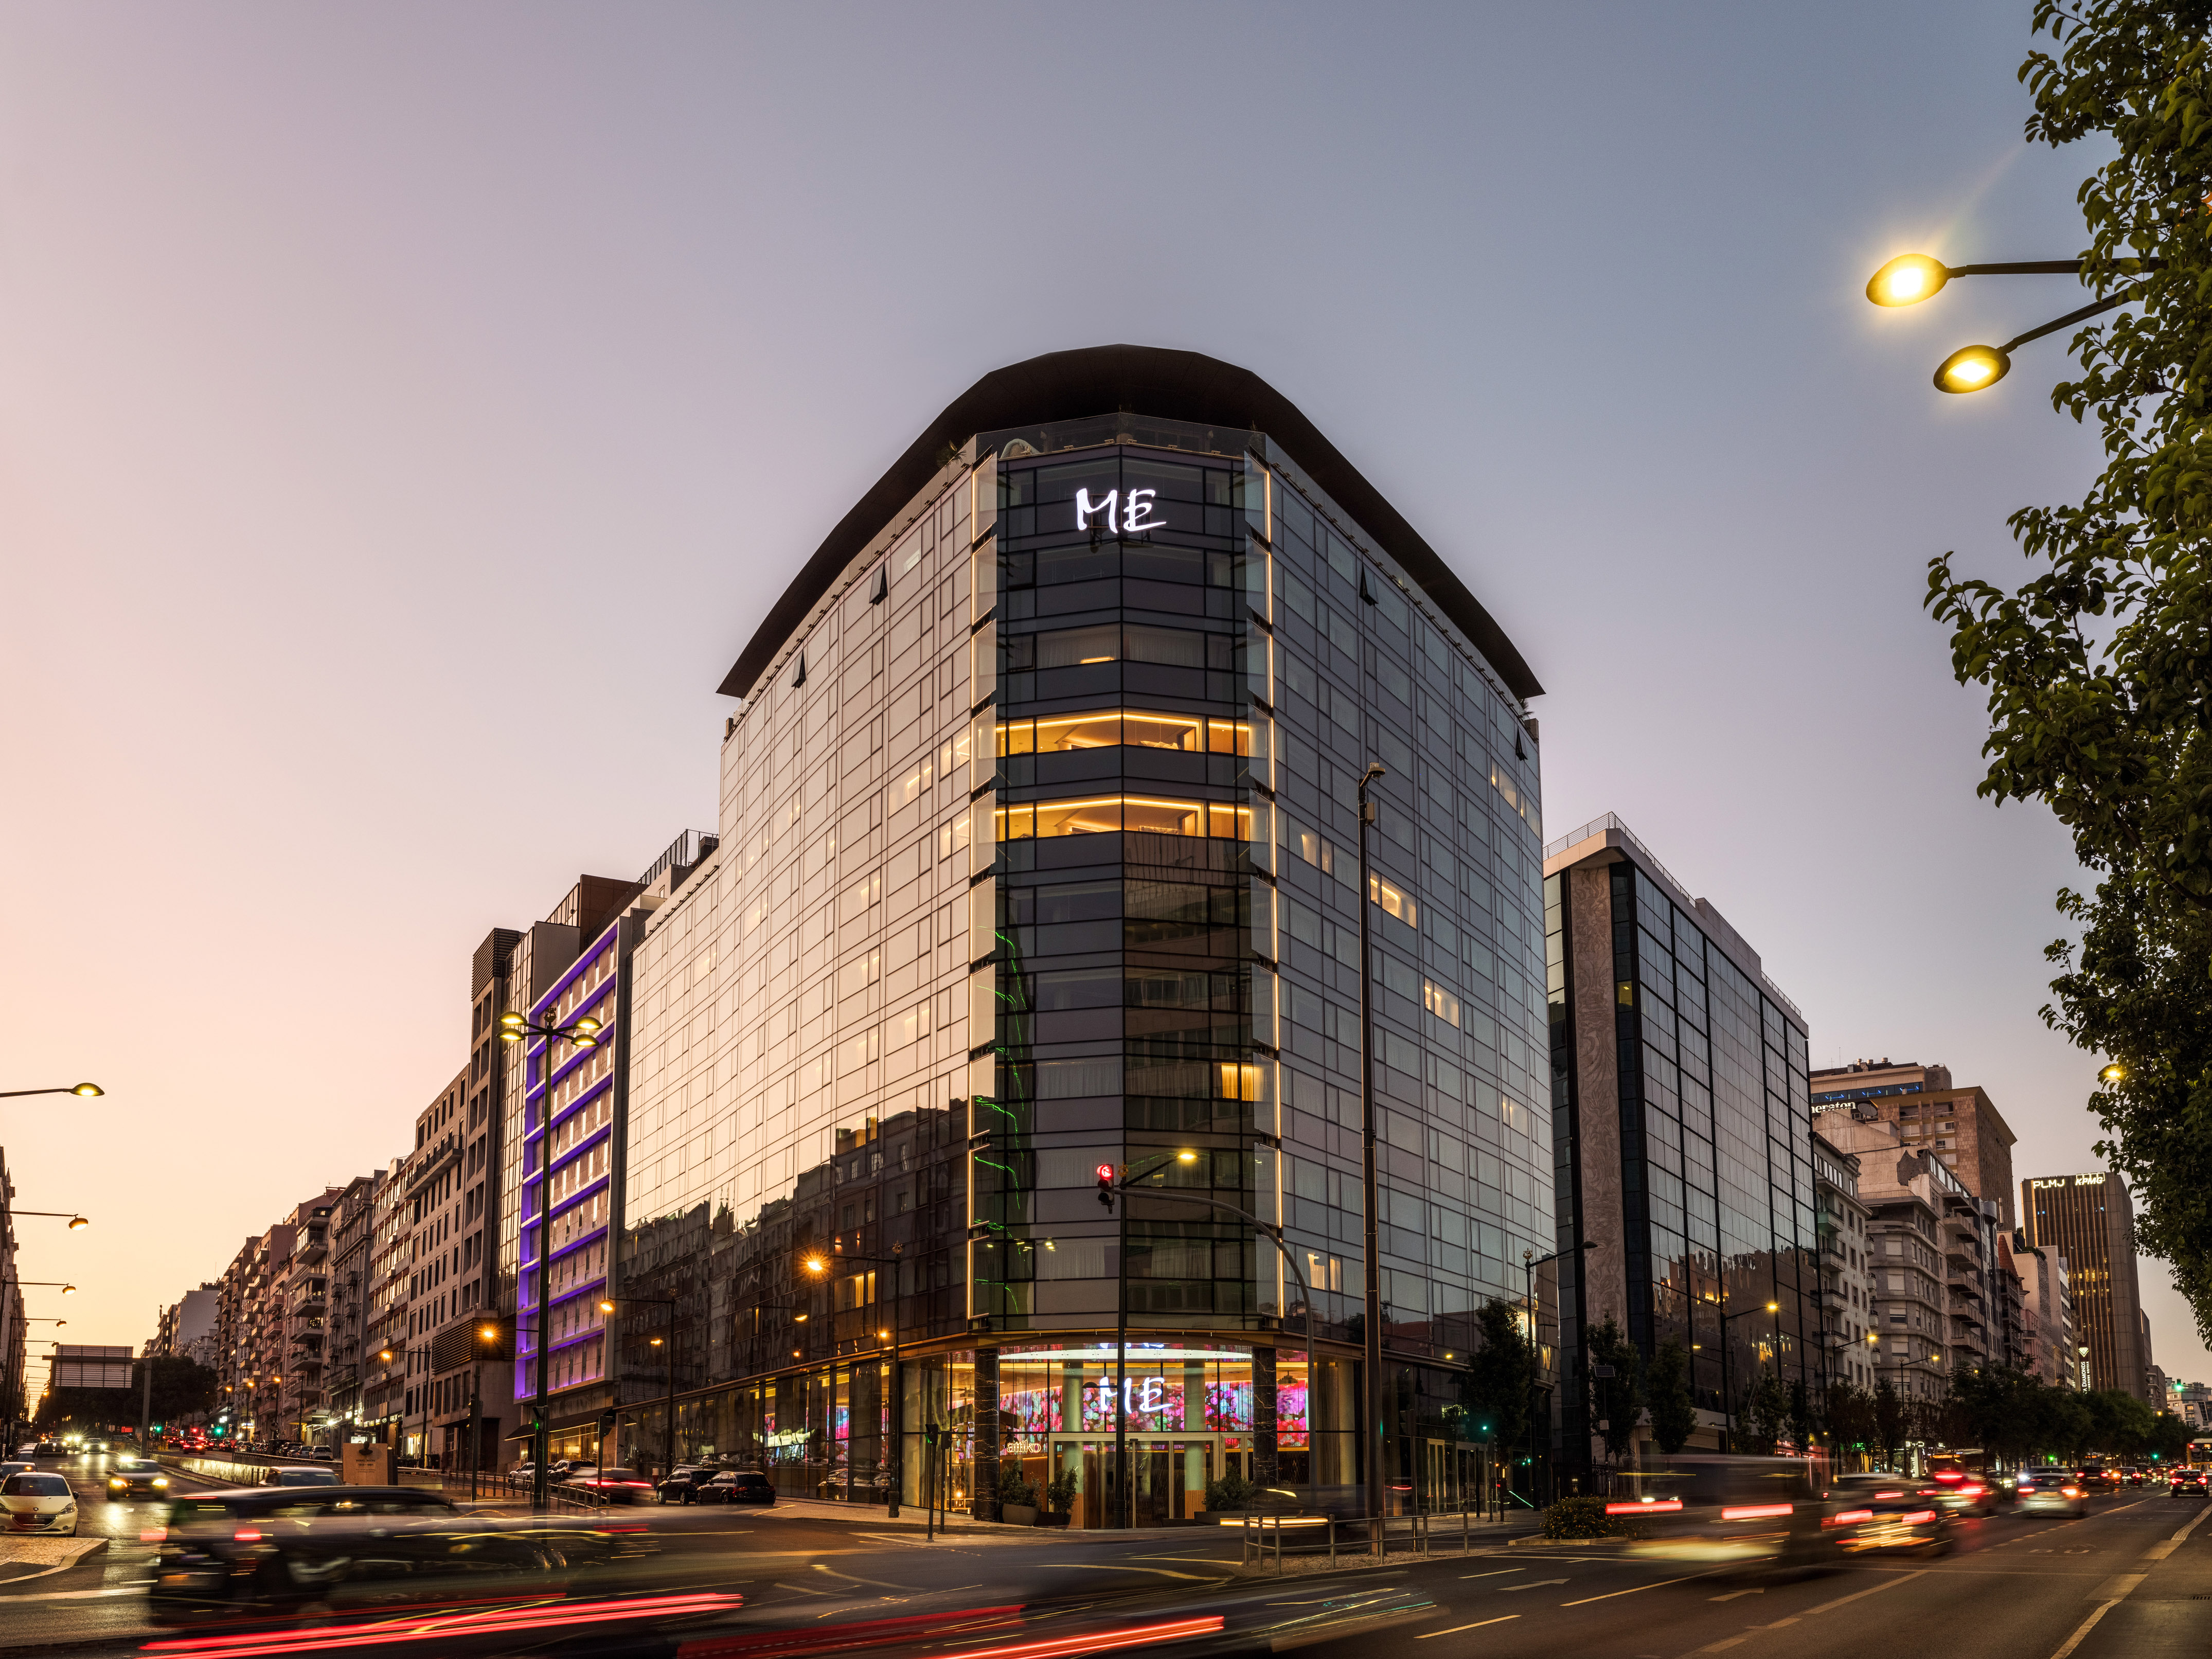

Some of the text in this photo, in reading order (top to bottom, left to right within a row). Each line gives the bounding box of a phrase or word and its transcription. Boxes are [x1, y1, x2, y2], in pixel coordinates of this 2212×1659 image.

[1076, 488, 1167, 534] ME
[1811, 1101, 1857, 1114] eraton
[2033, 1179, 2065, 1189] PLMJ
[2075, 1176, 2104, 1186] KPMG
[1099, 1376, 1173, 1414] ME
[1007, 1440, 1041, 1453] attiko
